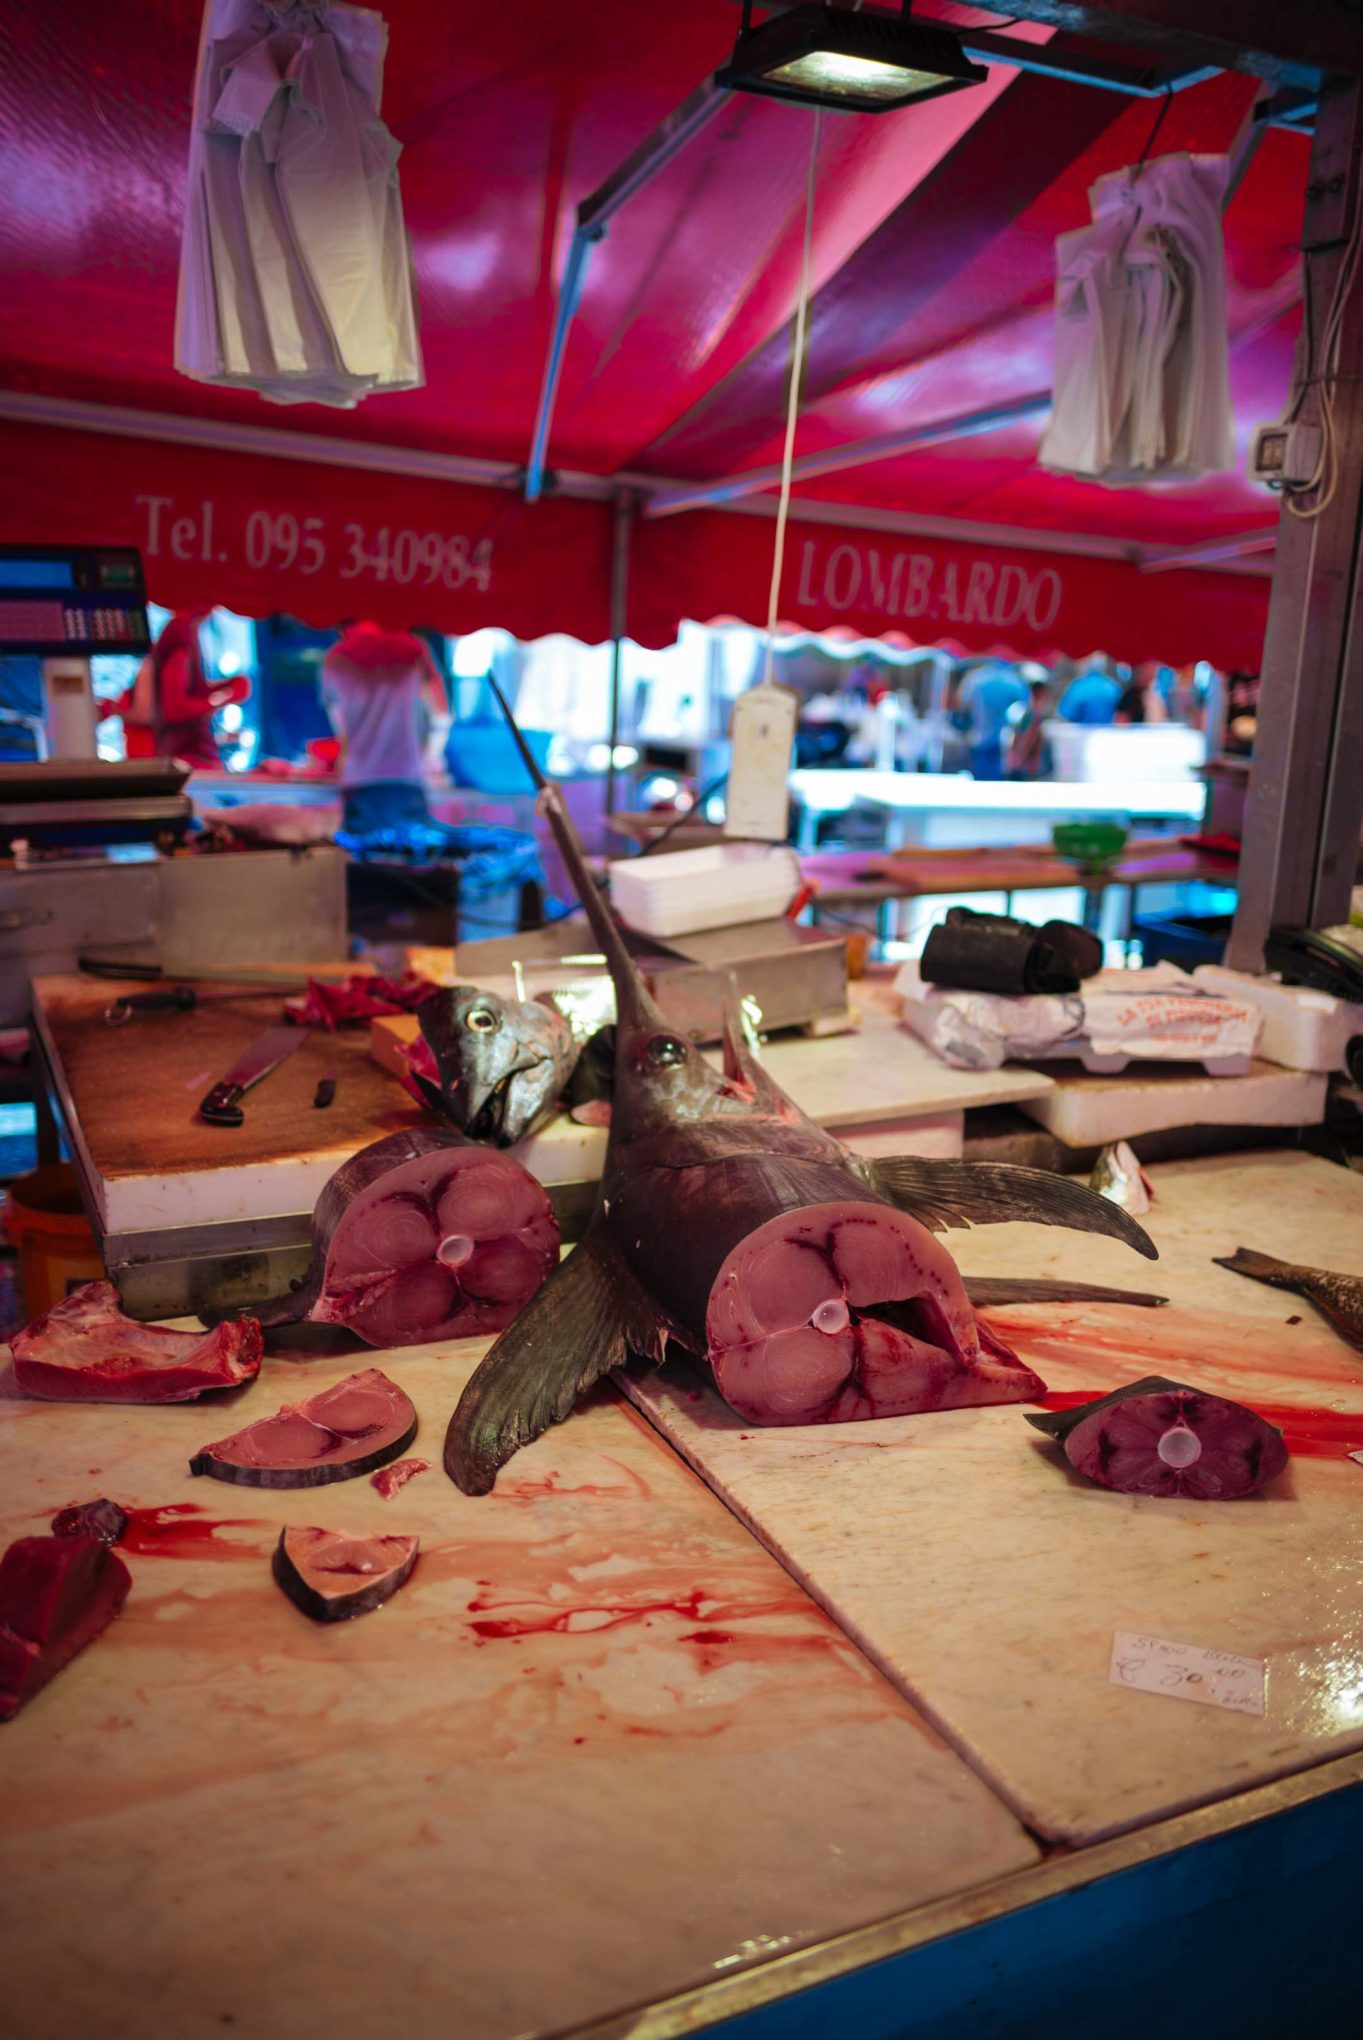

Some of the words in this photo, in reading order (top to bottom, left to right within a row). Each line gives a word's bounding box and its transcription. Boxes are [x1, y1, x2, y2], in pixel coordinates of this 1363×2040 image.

[135, 494, 228, 562] Tel.
[245, 509, 326, 575] 095
[339, 522, 495, 593] 340984
[797, 540, 1063, 631] LOMBARDO
